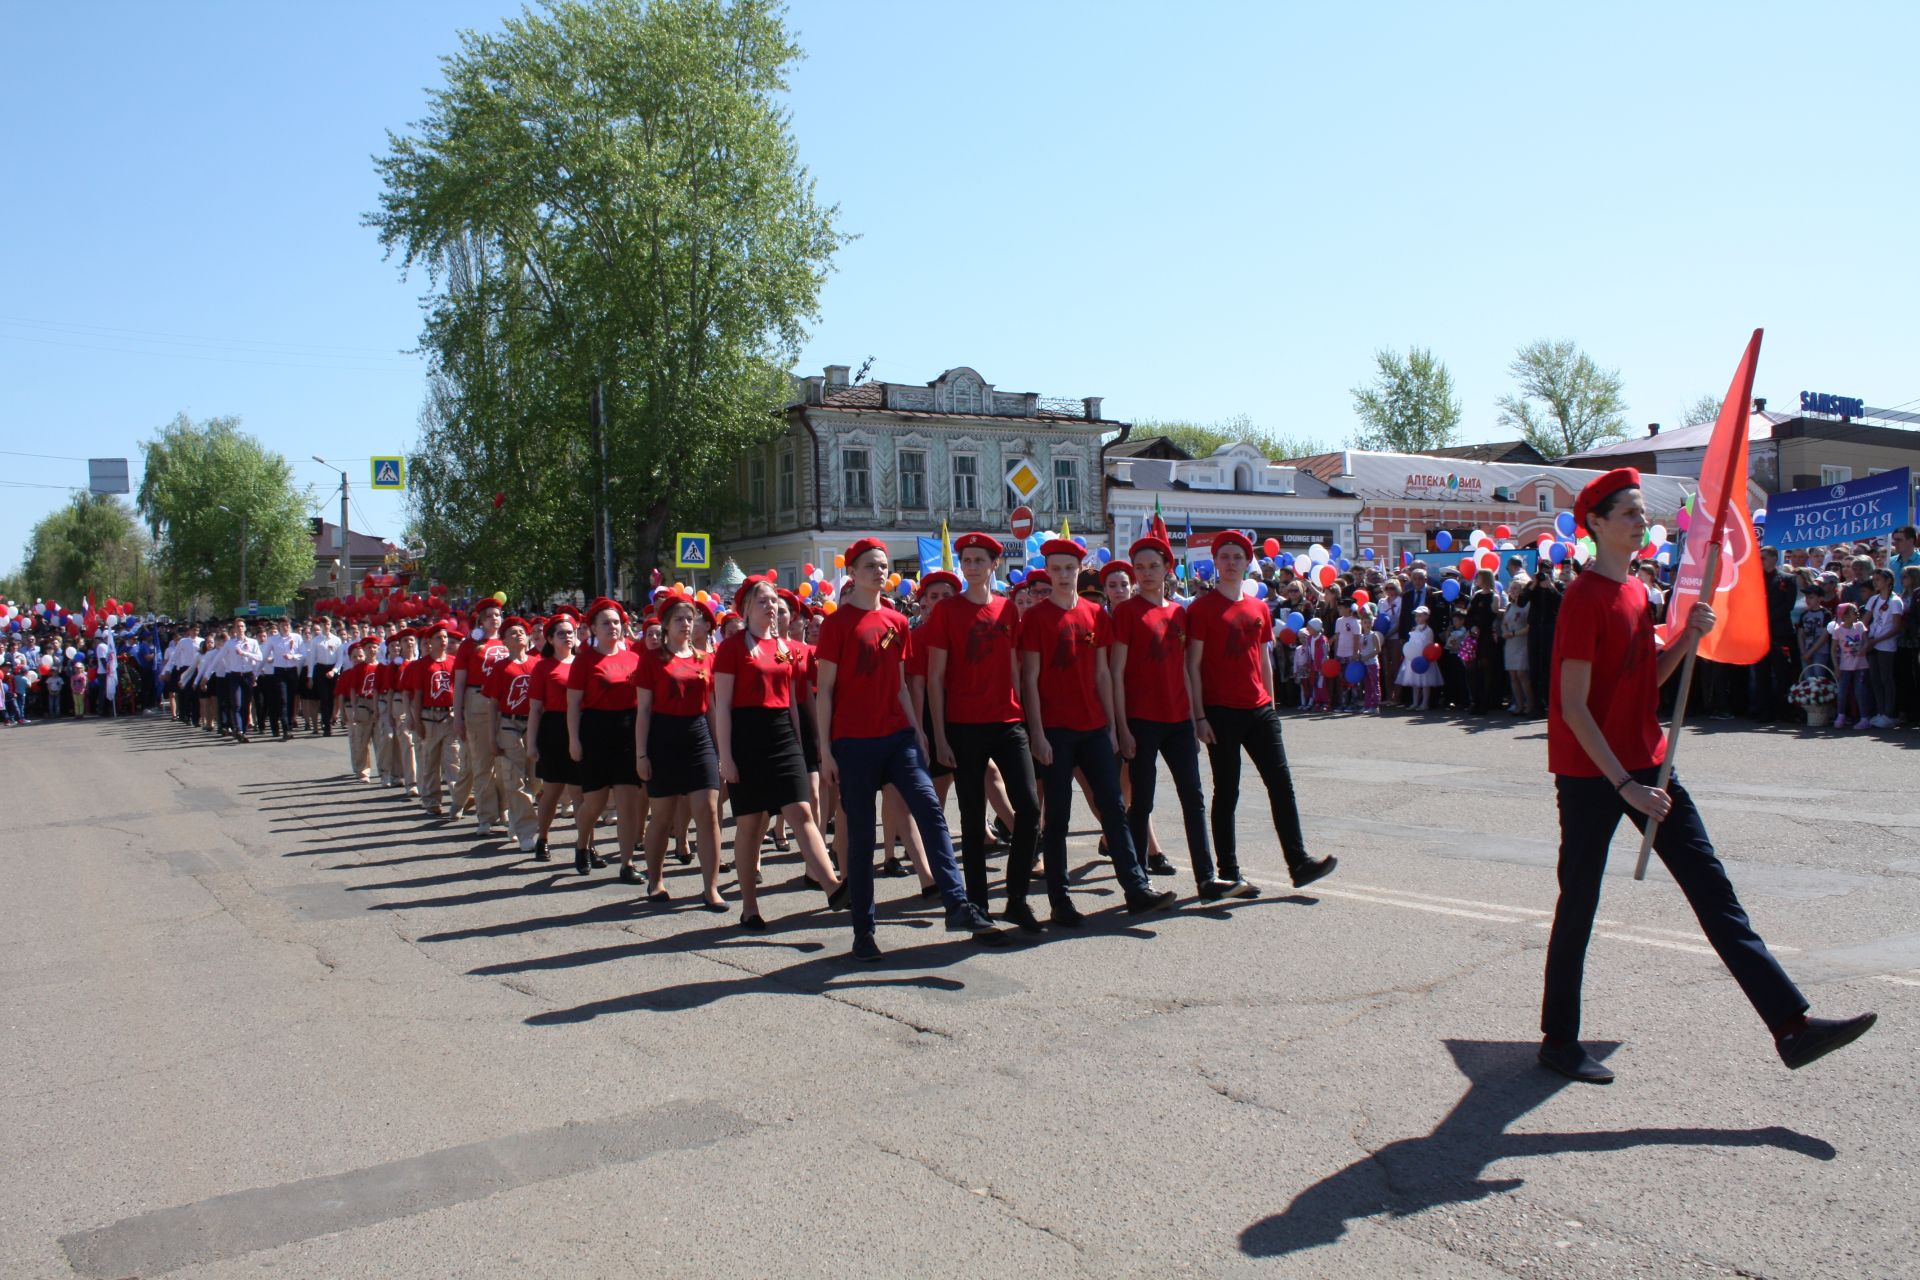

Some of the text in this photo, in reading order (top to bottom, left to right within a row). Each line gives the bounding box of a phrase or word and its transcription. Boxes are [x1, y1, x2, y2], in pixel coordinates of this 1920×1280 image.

[1800, 390, 1864, 418] SAMSUNG
[1407, 474, 1482, 489] АПТЕКА ВИТА
[1794, 499, 1881, 527] ВОСТОК
[1283, 534, 1324, 543] LOUNGE BAR
[1780, 512, 1893, 545] АМФИБИЯ
